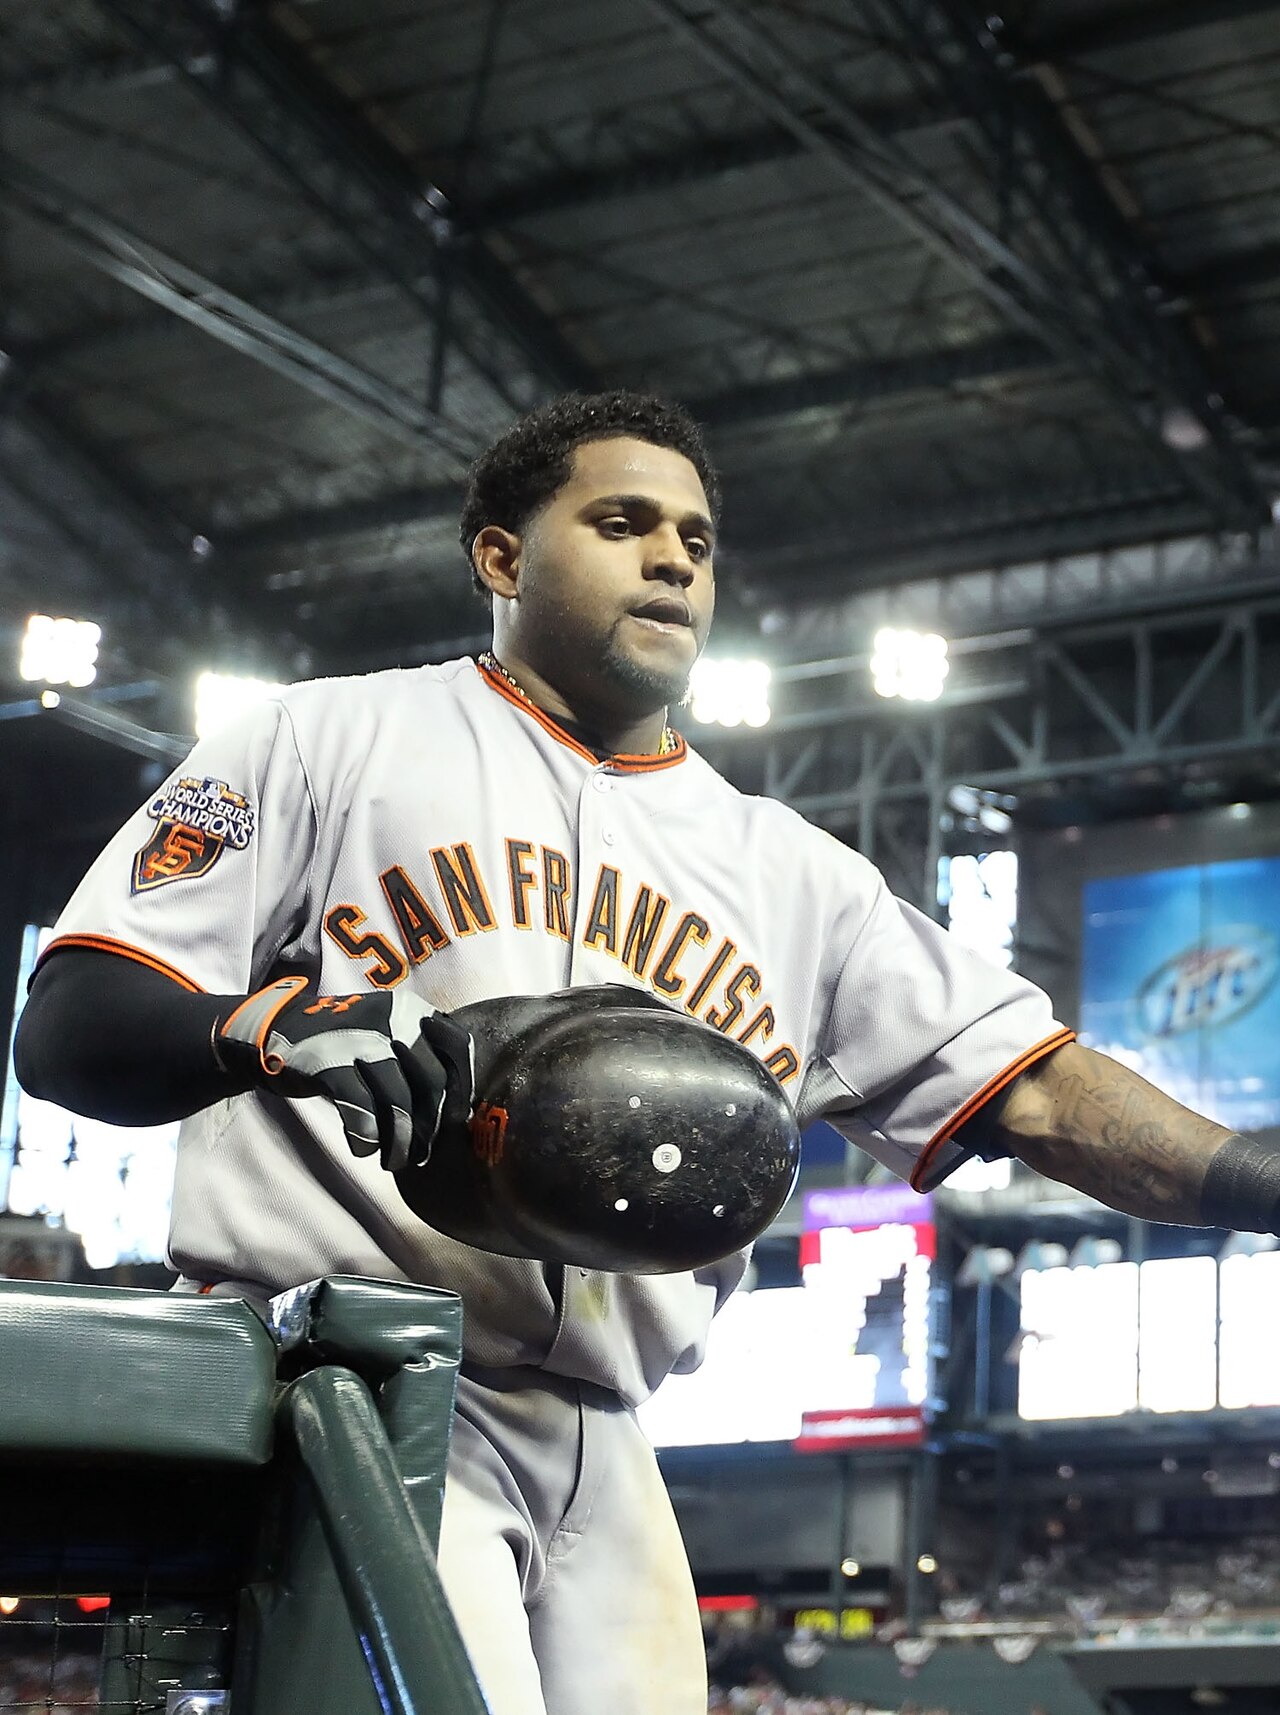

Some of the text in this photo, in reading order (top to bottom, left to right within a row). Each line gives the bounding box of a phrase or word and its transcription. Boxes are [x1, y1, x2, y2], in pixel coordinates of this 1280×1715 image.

[148, 794, 252, 849] CHAMPIONS
[166, 786, 254, 826] WORLD SERIES
[323, 841, 499, 989] SAN
